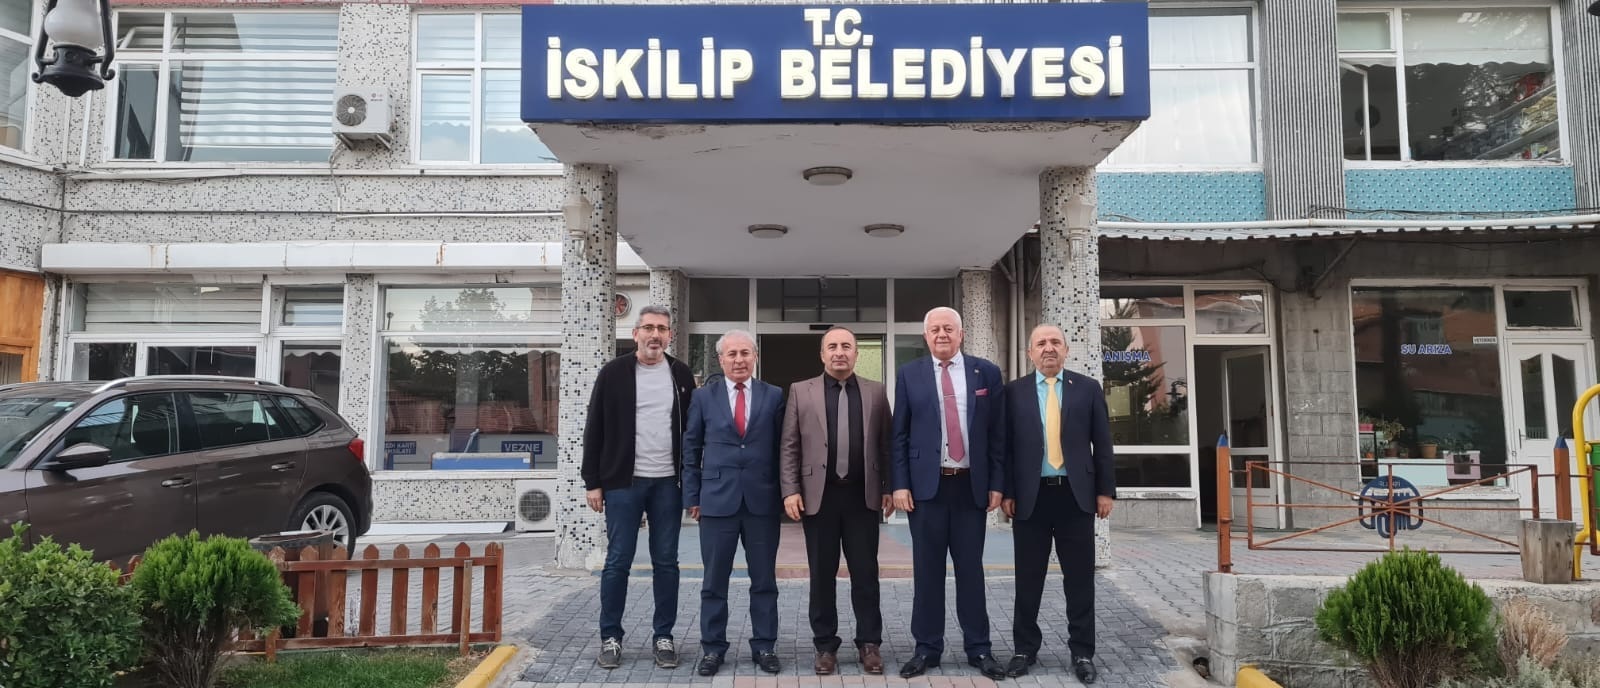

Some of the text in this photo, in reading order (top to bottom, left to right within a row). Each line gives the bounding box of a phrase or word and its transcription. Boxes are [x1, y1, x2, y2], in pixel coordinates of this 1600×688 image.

[803, 7, 874, 46] T.C.
[546, 35, 1125, 98] İSKİLİP BELEDİYESİ
[1400, 344, 1452, 354] SU ARIZA
[1101, 350, 1152, 363] ANIŞMA
[504, 443, 540, 451] VEZNE
